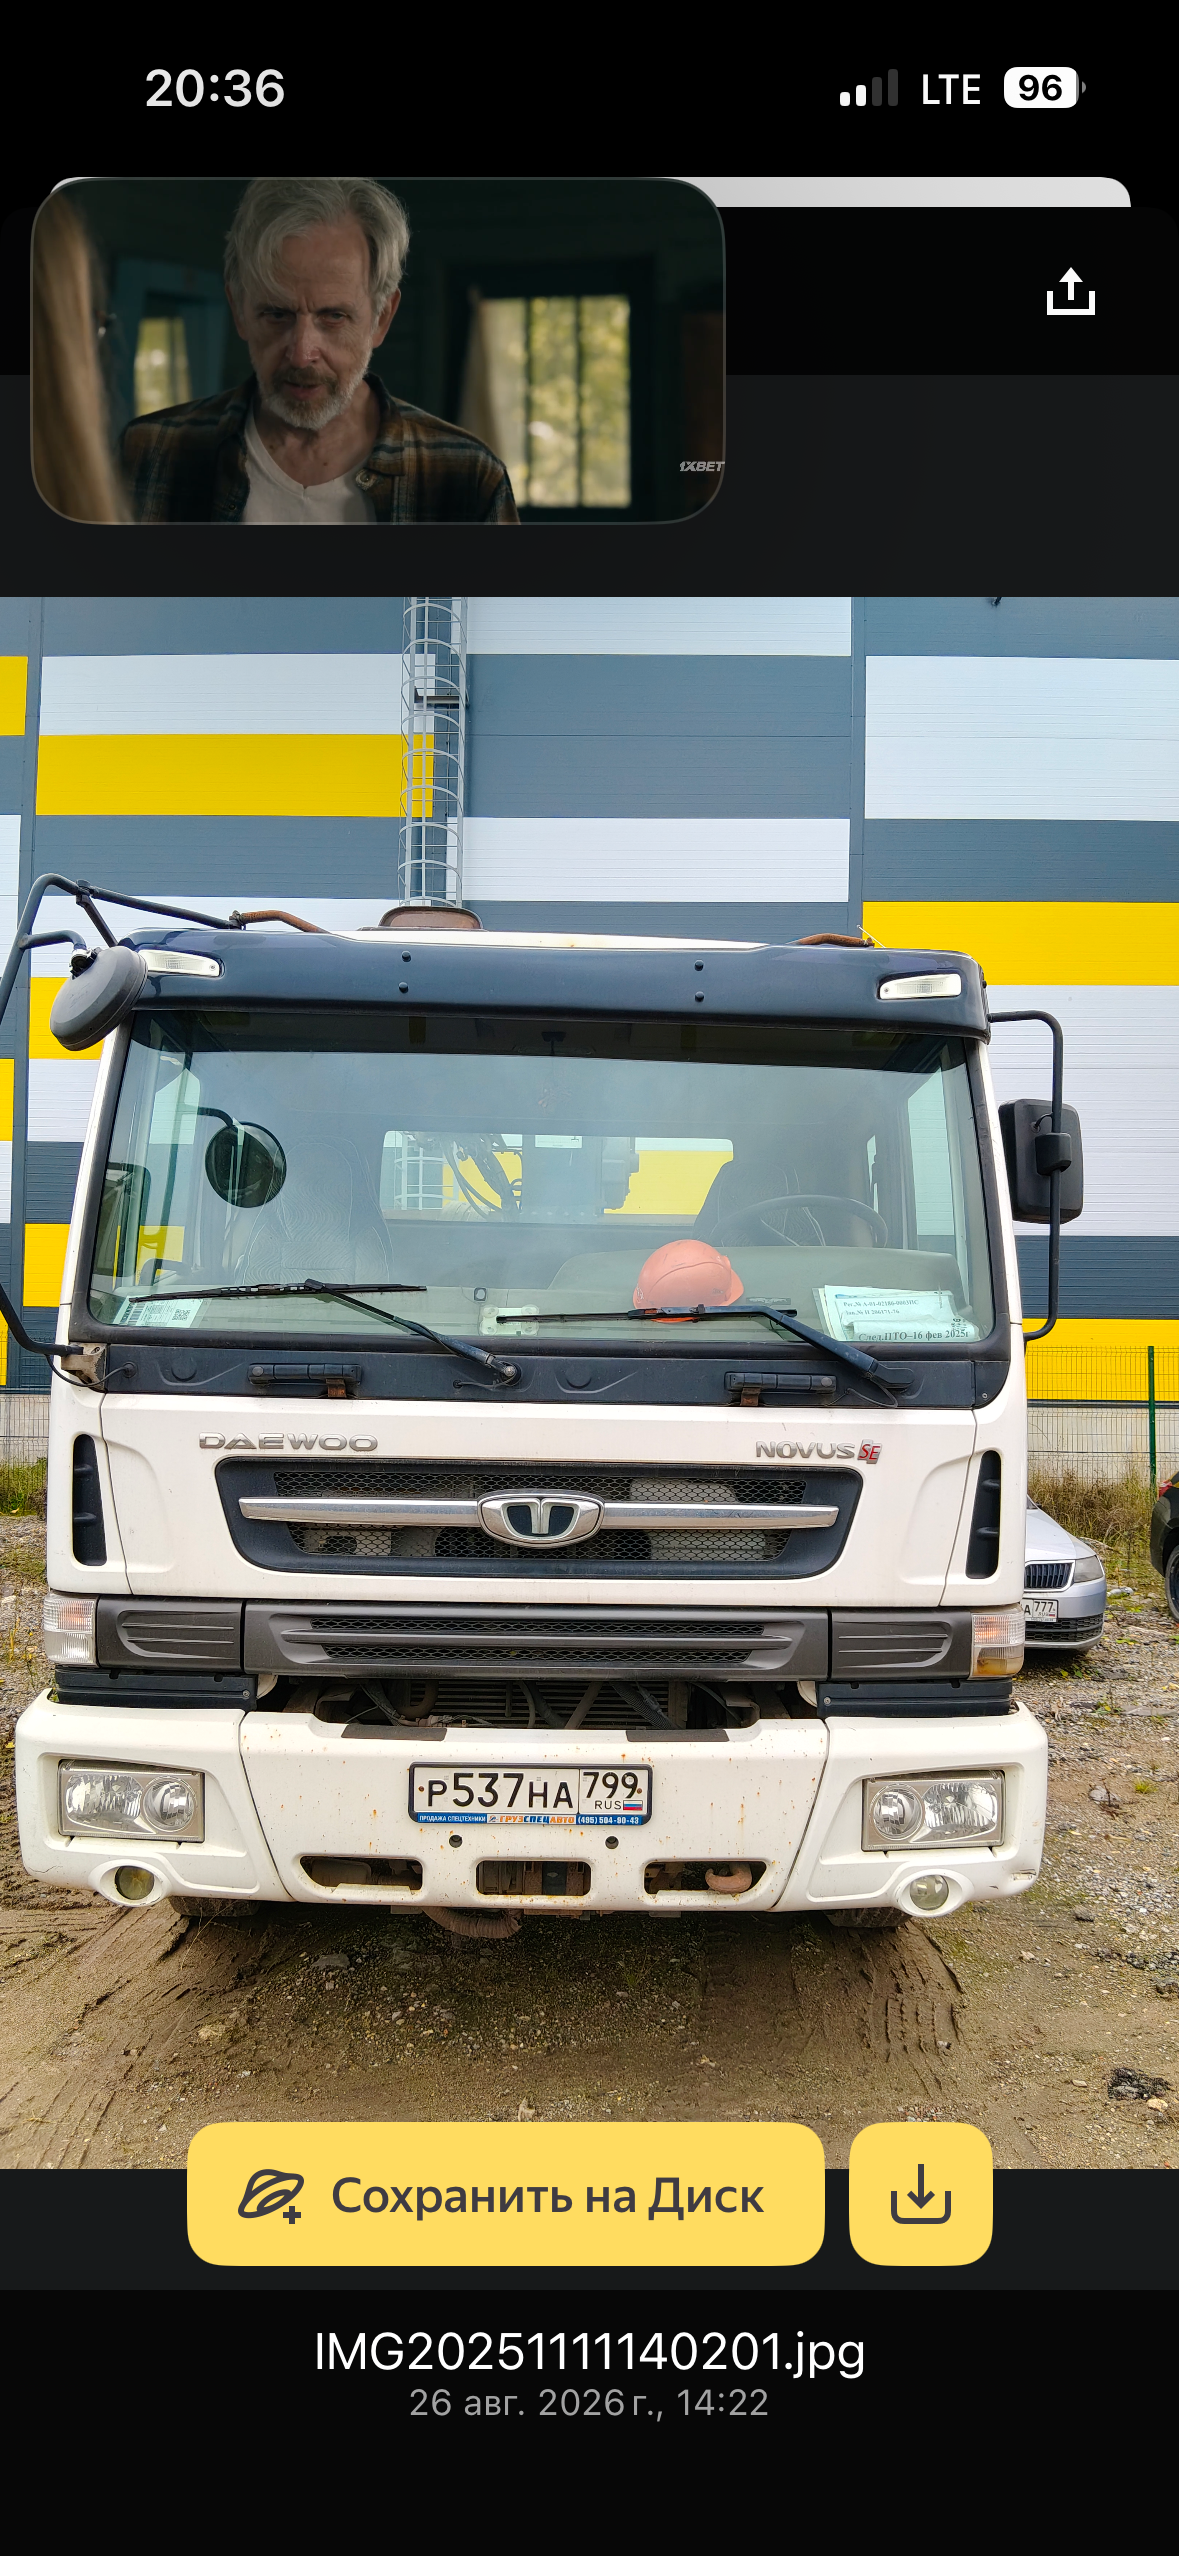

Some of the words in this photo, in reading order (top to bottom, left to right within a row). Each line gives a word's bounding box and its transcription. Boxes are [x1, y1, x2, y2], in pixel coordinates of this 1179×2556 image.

[925, 1331, 943, 1342] фев
[199, 1432, 378, 1451] DAEWOO
[755, 1440, 856, 1459] NOVUS
[859, 1442, 881, 1461] SE
[1034, 1601, 1054, 1613] 777
[583, 1771, 639, 1799] 799
[594, 1800, 622, 1810] RUS
[447, 1815, 486, 1823] СПЕЦТЕХНИКИ
[577, 1816, 598, 1825] (495)
